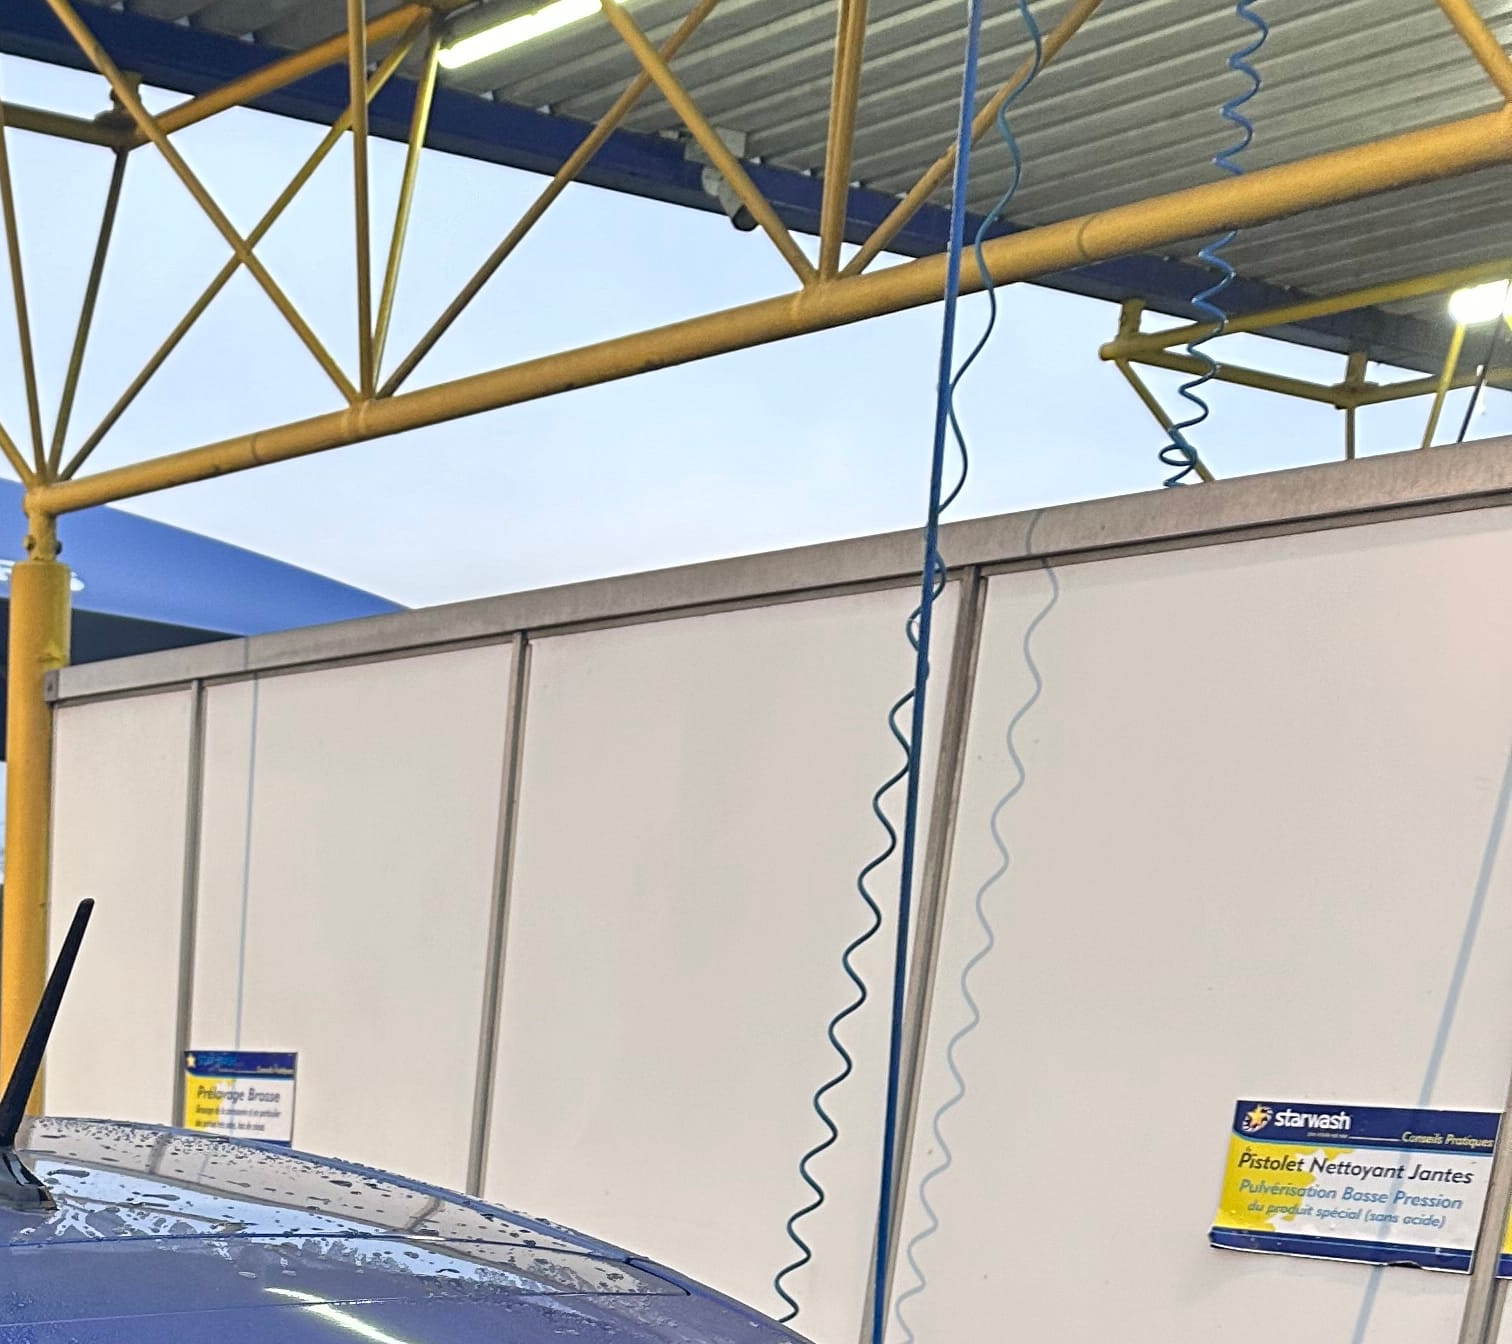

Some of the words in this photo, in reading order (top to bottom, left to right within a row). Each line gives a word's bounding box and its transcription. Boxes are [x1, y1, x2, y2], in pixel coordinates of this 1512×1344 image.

[1274, 1108, 1351, 1130] starwash
[1401, 1131, 1443, 1145] Conseils
[1445, 1134, 1494, 1149] Pratiques
[1238, 1151, 1304, 1172] Pistolet
[1309, 1157, 1406, 1180] Nettoyant
[1408, 1164, 1474, 1184] Jantes
[1239, 1179, 1337, 1199] Pulvérisation
[1342, 1186, 1388, 1203] Basse
[1393, 1190, 1463, 1209] Pression
[1248, 1200, 1264, 1211] du
[1266, 1203, 1313, 1216] produit
[1316, 1207, 1362, 1220] spécial
[1365, 1208, 1399, 1222] (sans
[1403, 1214, 1446, 1229] acide)
